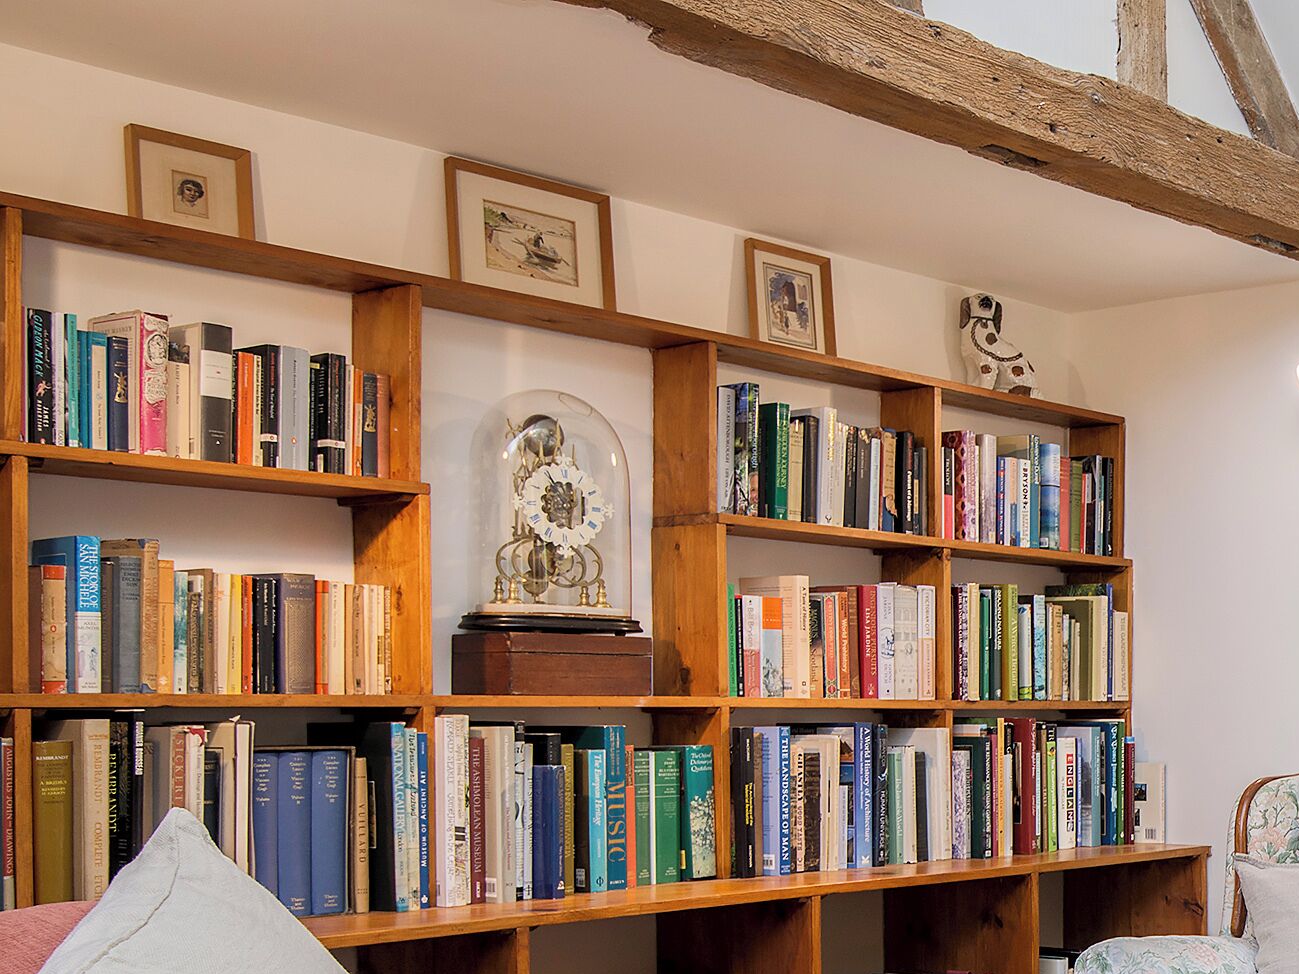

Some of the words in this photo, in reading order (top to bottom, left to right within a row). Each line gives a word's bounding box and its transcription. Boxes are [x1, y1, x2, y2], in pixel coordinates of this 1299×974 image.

[33, 314, 43, 347] GIDEON
[34, 350, 44, 378] MACK
[79, 544, 89, 563] SAN
[89, 545, 98, 562] THE
[79, 564, 89, 608] MICHELE
[89, 565, 98, 594] STORY
[89, 594, 98, 608] OF
[746, 620, 754, 648] Bryson
[1011, 618, 1017, 626] A
[6, 748, 14, 792] AUGUSTUS
[135, 748, 144, 776] ROUSSEAU
[174, 738, 184, 802] SICKERT
[394, 742, 405, 790] NATIONAL
[472, 747, 481, 768] THE
[594, 754, 602, 767] The
[94, 744, 102, 803] REMBRANDT
[591, 768, 602, 798] European
[863, 760, 871, 786] History
[109, 752, 118, 832] REMBRANDT
[472, 768, 482, 830] ASHMOLEAN
[864, 788, 871, 796] of
[6, 796, 14, 819] JOHN
[395, 791, 406, 832] GALLERY
[592, 799, 602, 826] Heritage
[607, 780, 626, 862] MUSIC
[358, 803, 366, 864] VUILLARD
[396, 831, 404, 852] London
[421, 824, 427, 833] OF
[782, 821, 788, 835] OF
[6, 828, 14, 874] DRAWINGS
[94, 822, 102, 868] COMPLETE
[474, 831, 482, 873] MUSEUM
[94, 875, 102, 901] ETCH
